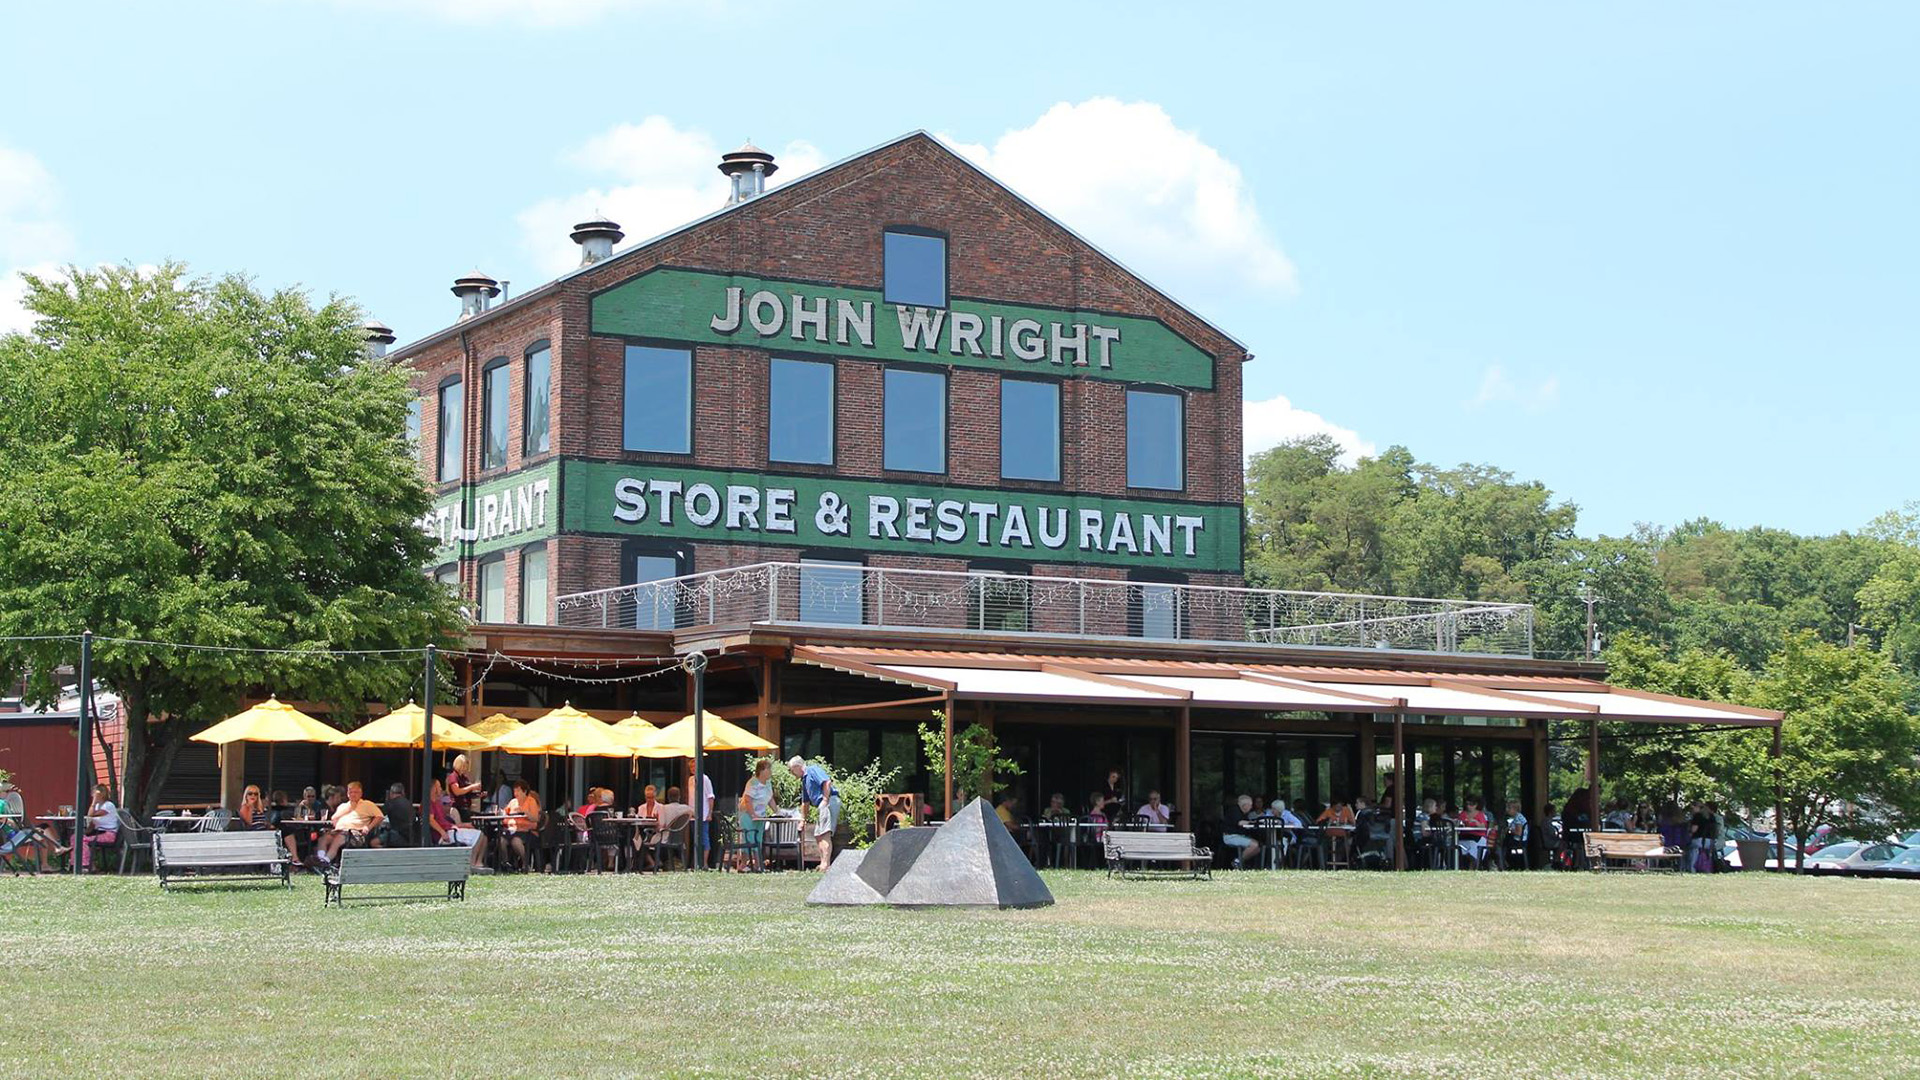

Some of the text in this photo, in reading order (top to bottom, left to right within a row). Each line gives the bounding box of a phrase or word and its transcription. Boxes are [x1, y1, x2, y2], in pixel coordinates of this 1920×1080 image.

[710, 287, 1120, 370] JOHN WRIGHT
[413, 478, 549, 546] STAURANT
[612, 477, 1204, 556] STORE & RESTAURANT
